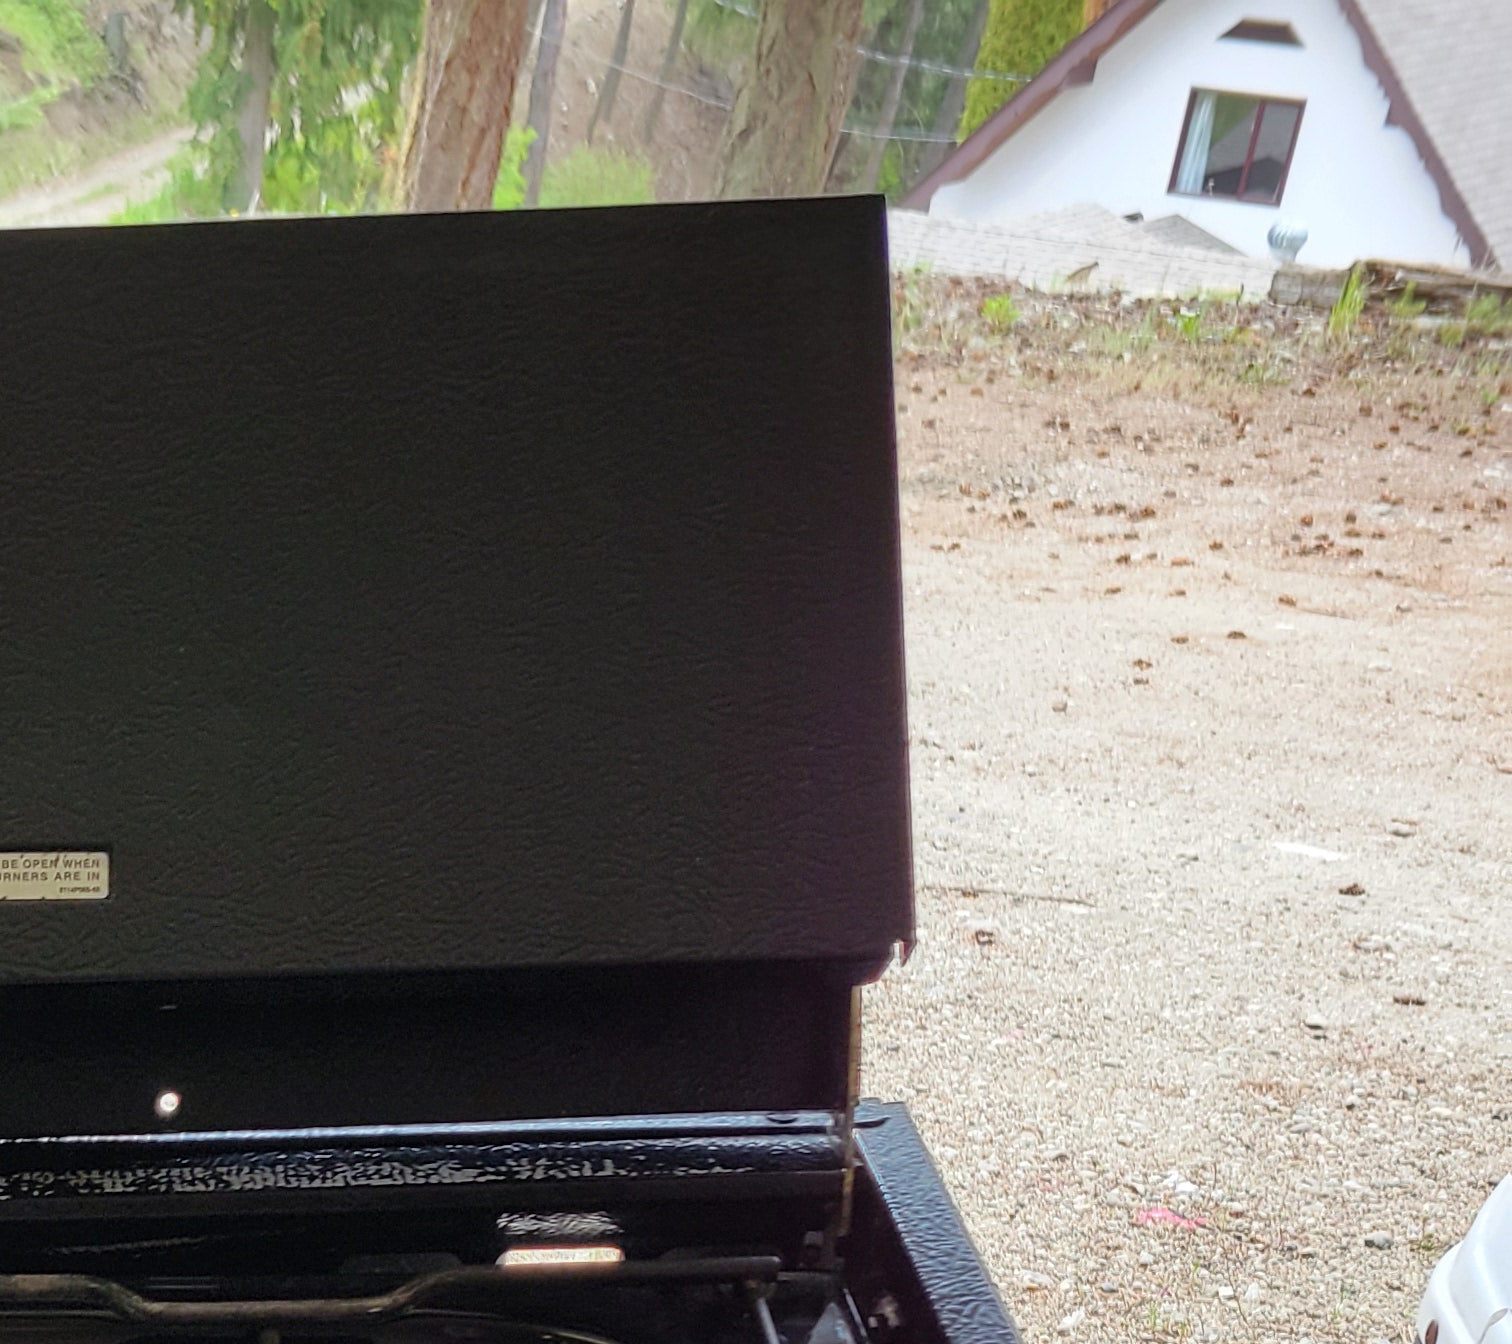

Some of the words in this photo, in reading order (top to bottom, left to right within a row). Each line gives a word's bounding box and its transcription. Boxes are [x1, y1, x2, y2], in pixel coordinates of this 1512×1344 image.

[2, 858, 18, 869] BE
[23, 858, 58, 869] OPEN
[63, 857, 100, 868] WHEN
[54, 870, 81, 881] ARE
[87, 870, 100, 881] IN
